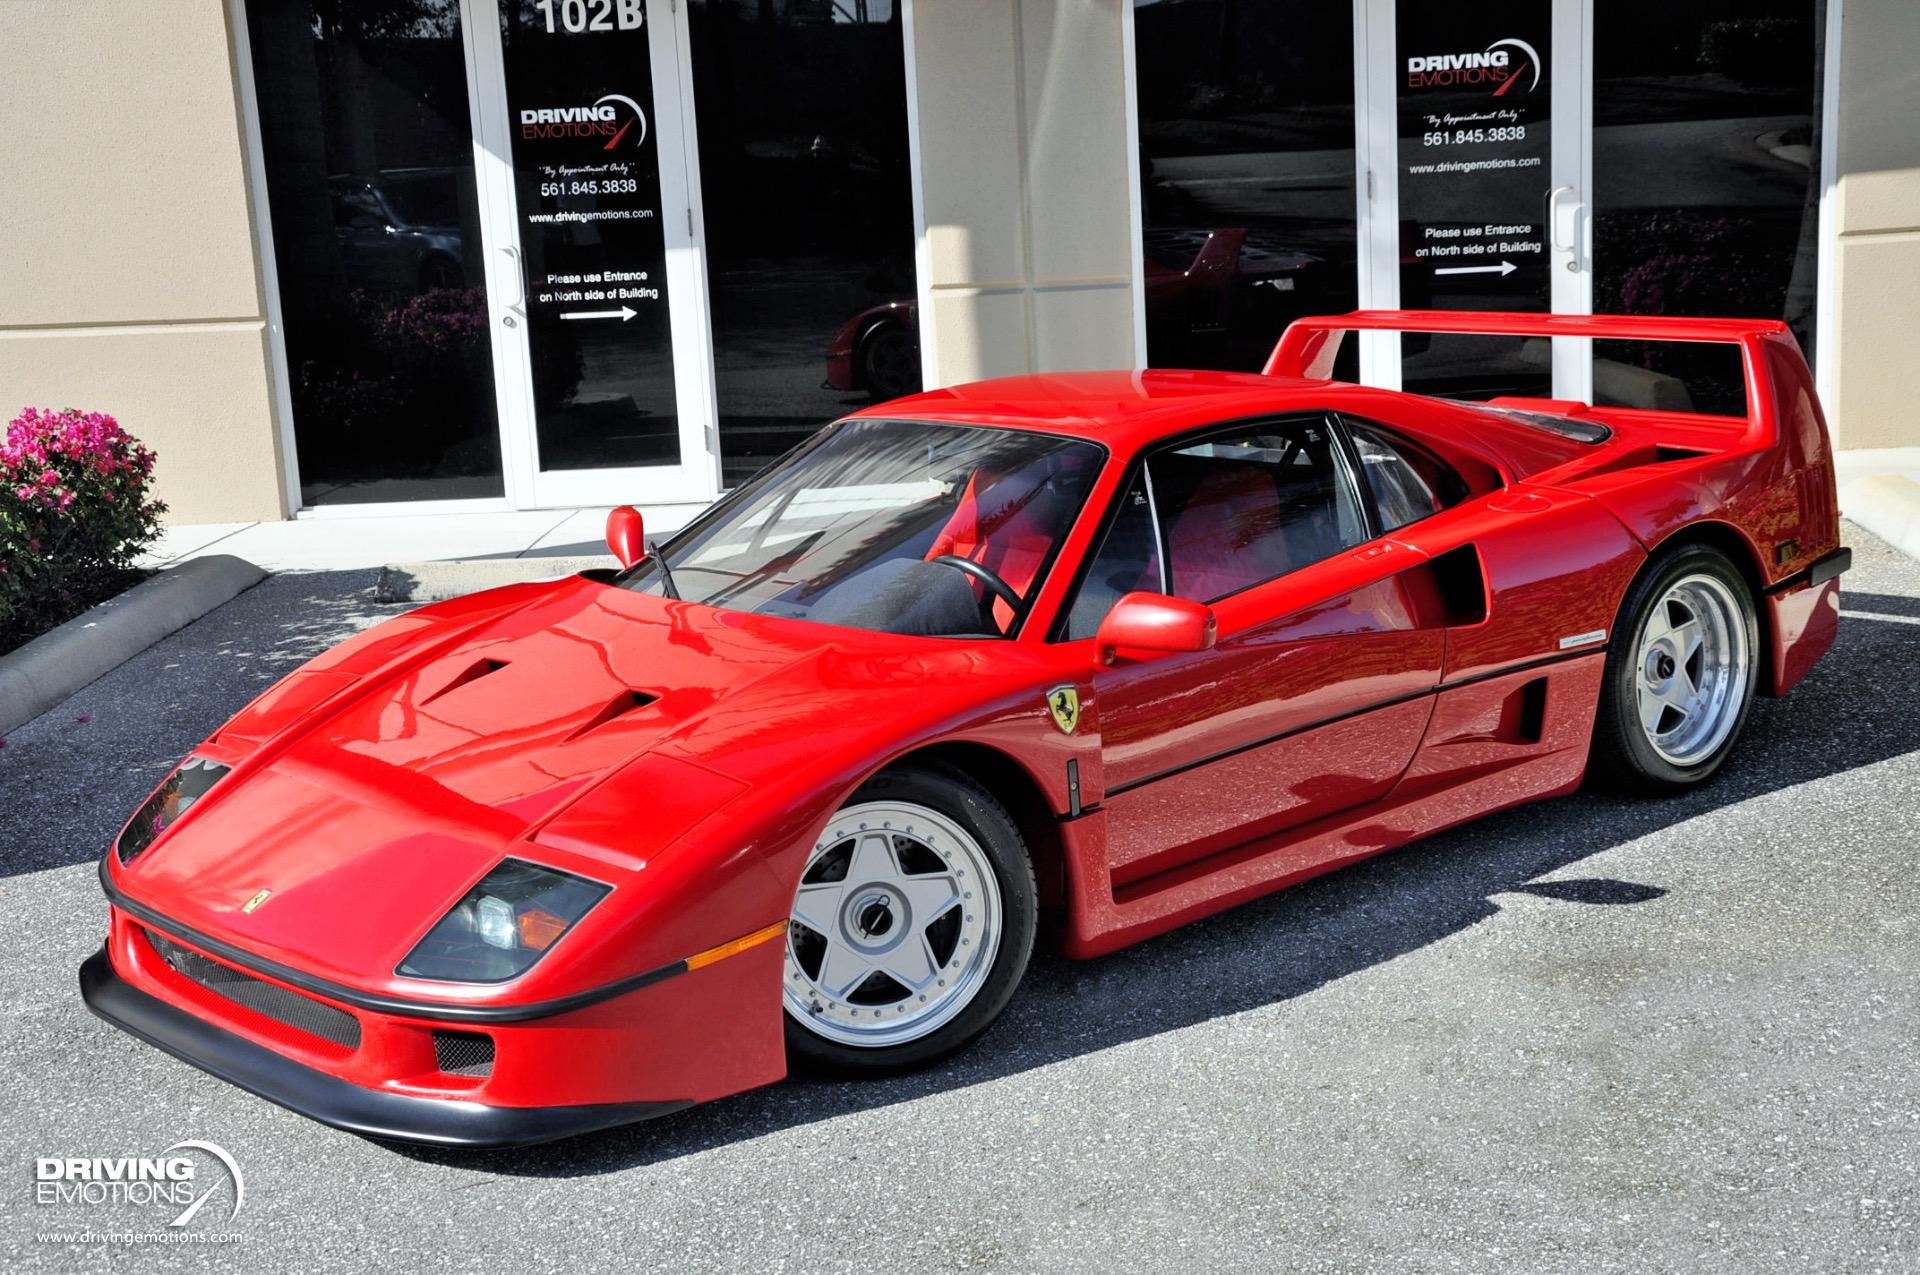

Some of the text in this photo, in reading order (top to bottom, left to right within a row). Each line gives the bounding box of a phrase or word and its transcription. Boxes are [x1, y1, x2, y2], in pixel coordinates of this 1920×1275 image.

[536, 0, 643, 33] 102B
[1408, 50, 1509, 73] DRIVING
[1408, 66, 1509, 88] EMOTIONS
[520, 106, 616, 124] DRIVING
[1443, 111, 1497, 125] Appointment
[522, 121, 617, 139] EMOTIONS
[1423, 126, 1526, 146] 561.845.3838
[558, 164, 609, 175] Appointment
[1409, 157, 1541, 174] www.drivingemotions.com
[540, 179, 637, 197] 561.845.3838
[529, 209, 653, 223] www.drivingemotions.com
[1425, 224, 1532, 238] Please use Entrance
[1415, 241, 1542, 257] on North side of Building
[547, 270, 648, 284] Please use Entrance
[539, 287, 659, 302] on North side of Building
